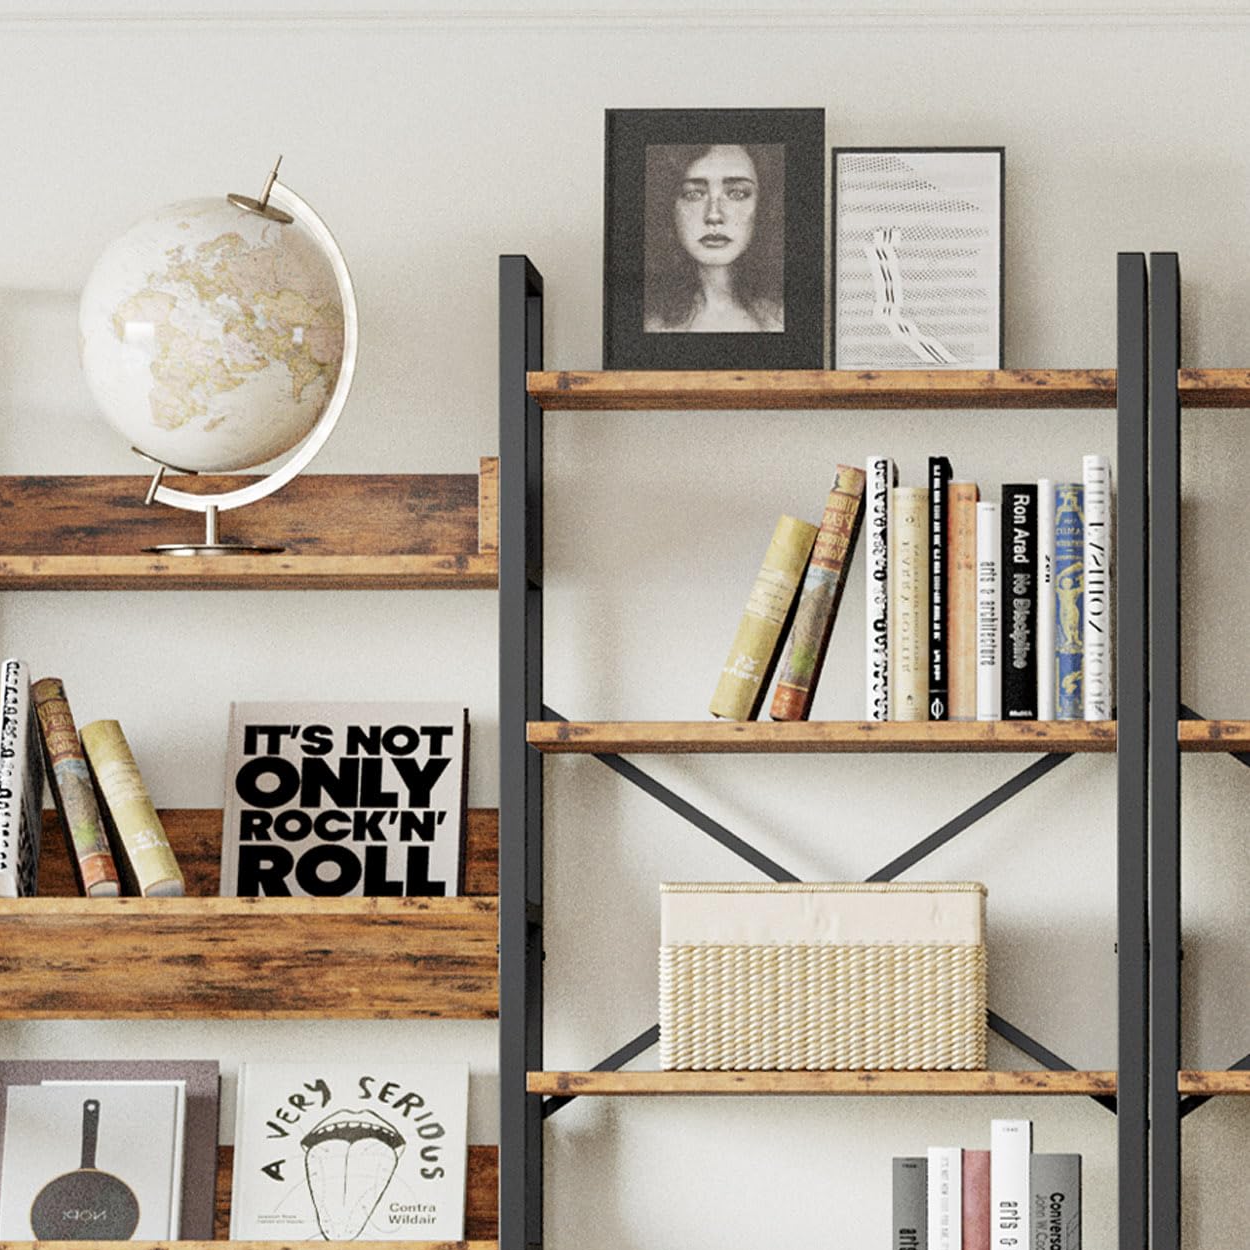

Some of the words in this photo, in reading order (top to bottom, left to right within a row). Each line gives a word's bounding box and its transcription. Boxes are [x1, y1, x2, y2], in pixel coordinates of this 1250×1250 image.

[1013, 494, 1030, 525] Ron
[1013, 528, 1030, 564] Arad
[980, 561, 997, 583] arts
[1013, 573, 1031, 595] No
[980, 601, 998, 666] architecture
[244, 725, 333, 756] IT'S
[347, 725, 453, 756] NOT
[235, 757, 452, 808] ONLY
[239, 810, 446, 842] ROCK'N'
[236, 845, 446, 897] ROLL
[266, 1078, 332, 1140] VERY
[358, 1076, 445, 1181] SERIOUS
[261, 1159, 287, 1182] A
[389, 1203, 436, 1213] Contra
[389, 1215, 437, 1225] Wildair
[1000, 1201, 1021, 1229] arts
[1036, 1193, 1047, 1219] John
[1000, 1238, 1018, 1246] &
